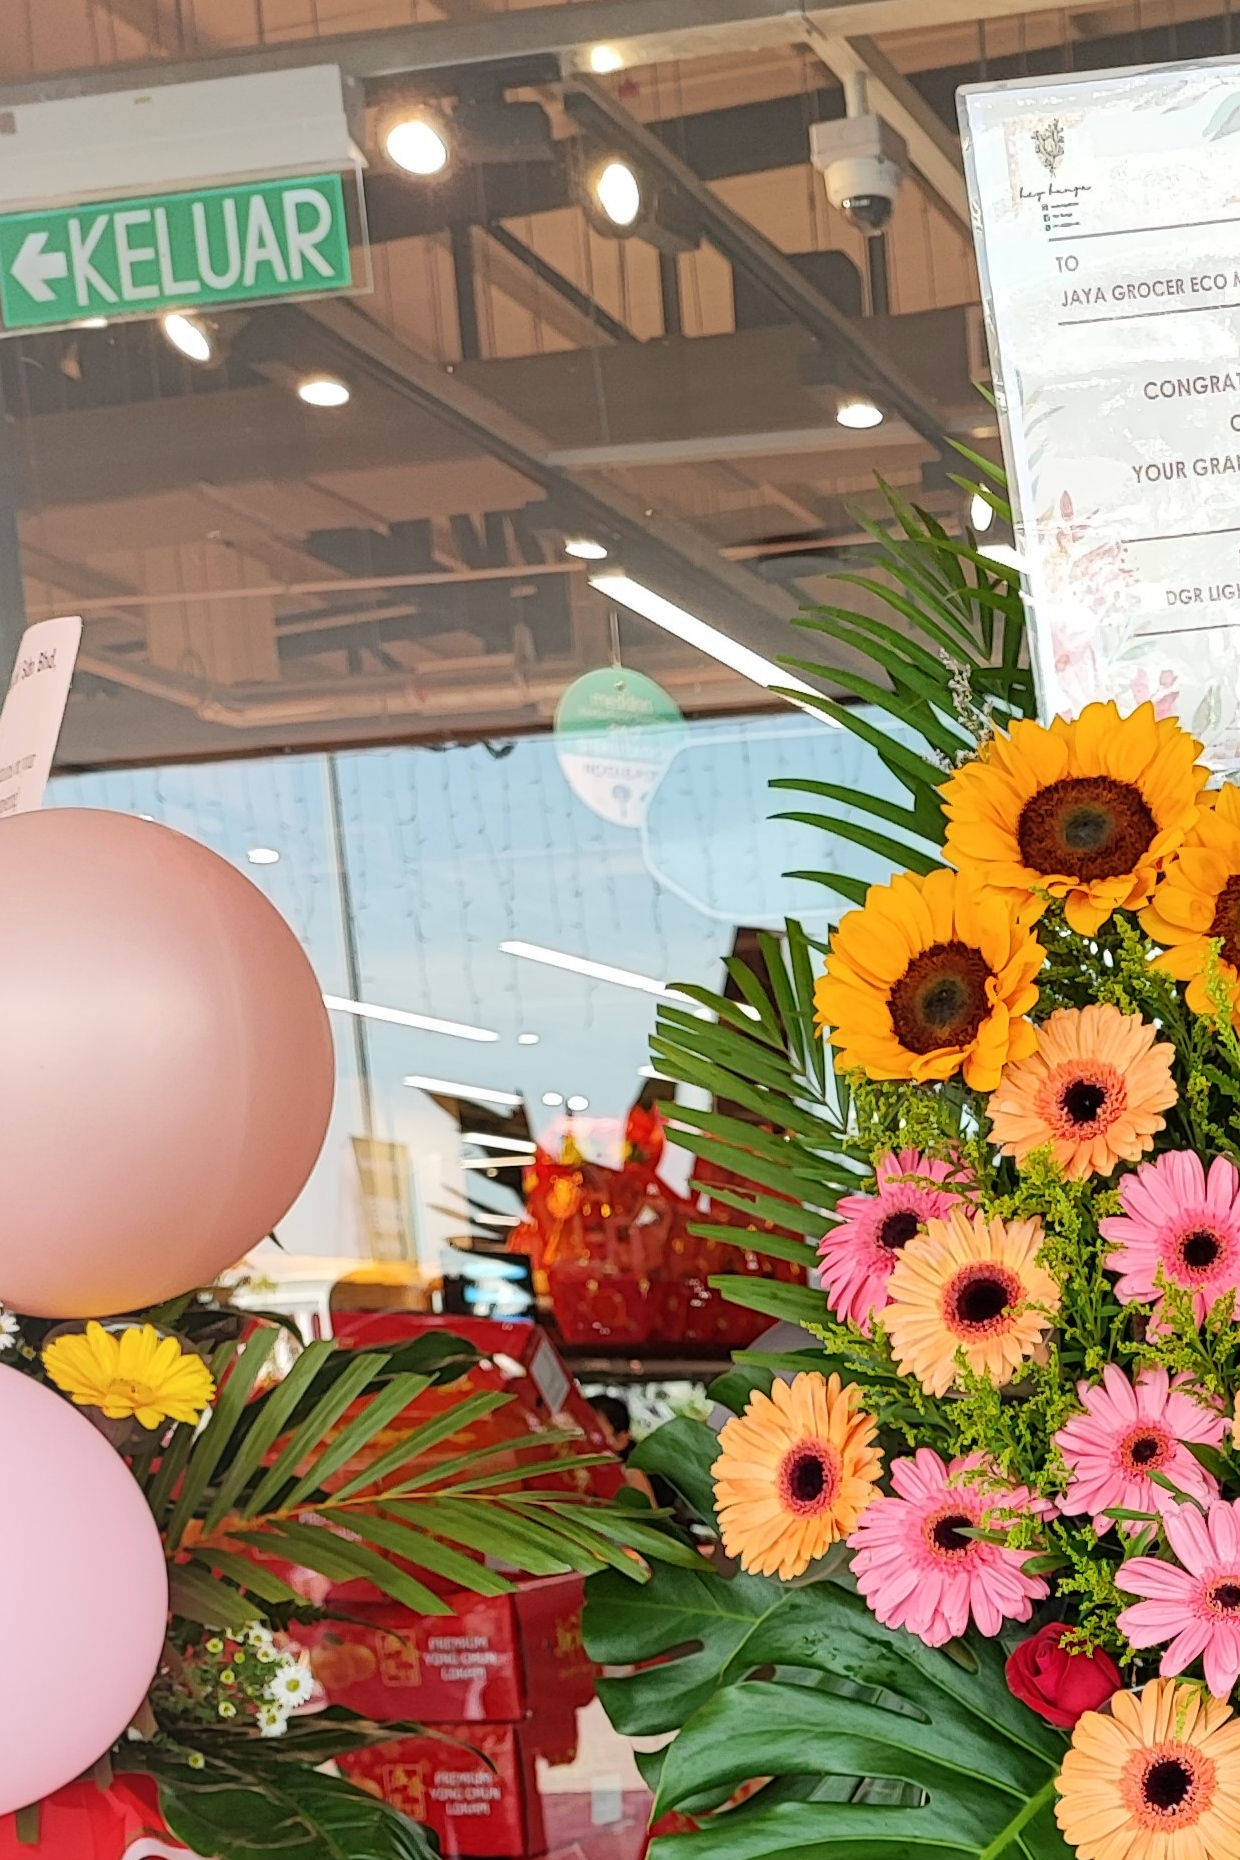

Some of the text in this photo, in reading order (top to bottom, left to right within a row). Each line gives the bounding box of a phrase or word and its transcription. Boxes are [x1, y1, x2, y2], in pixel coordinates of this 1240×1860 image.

[68, 188, 336, 306] KELUAR
[1056, 255, 1079, 273] TO
[1061, 287, 1107, 307] JAYA
[1111, 278, 1186, 301] GROCER
[1190, 273, 1228, 293] ECO
[1132, 461, 1187, 483] YOUR
[1166, 587, 1204, 606] DGR
